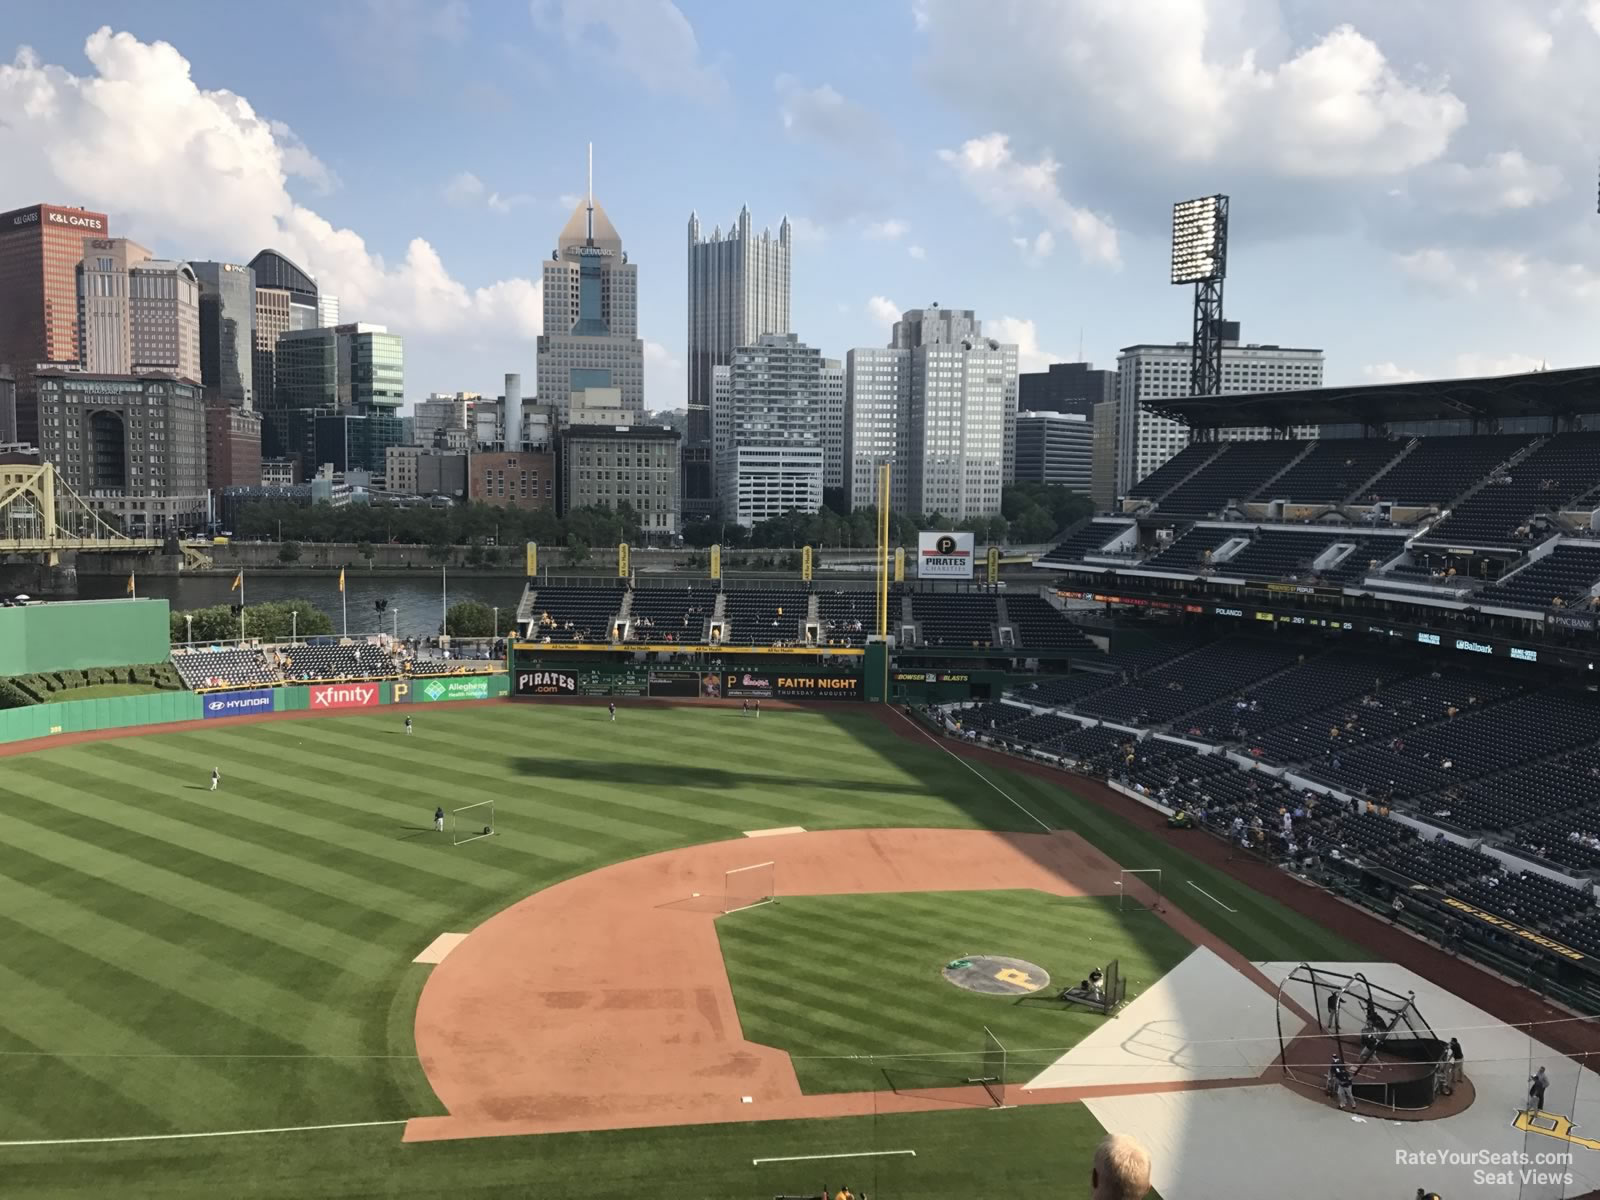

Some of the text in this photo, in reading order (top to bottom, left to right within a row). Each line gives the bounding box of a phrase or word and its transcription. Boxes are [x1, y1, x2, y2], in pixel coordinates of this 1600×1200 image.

[22, 212, 38, 223] GATES
[49, 213, 101, 229] K&L GATES
[92, 240, 116, 249] EQT
[942, 540, 951, 551] P
[1216, 608, 1242, 617] POLANCO
[1556, 617, 1591, 628] PNC BANK
[1464, 641, 1492, 654] Ballpark
[449, 682, 488, 691] Allegheny
[519, 672, 575, 690] PIRATES
[727, 676, 737, 688] P
[778, 678, 814, 688] FAITH
[818, 679, 857, 688] NIGHT
[315, 686, 374, 706] xfinity
[394, 683, 408, 702] P
[227, 698, 269, 708] HYUNDAI
